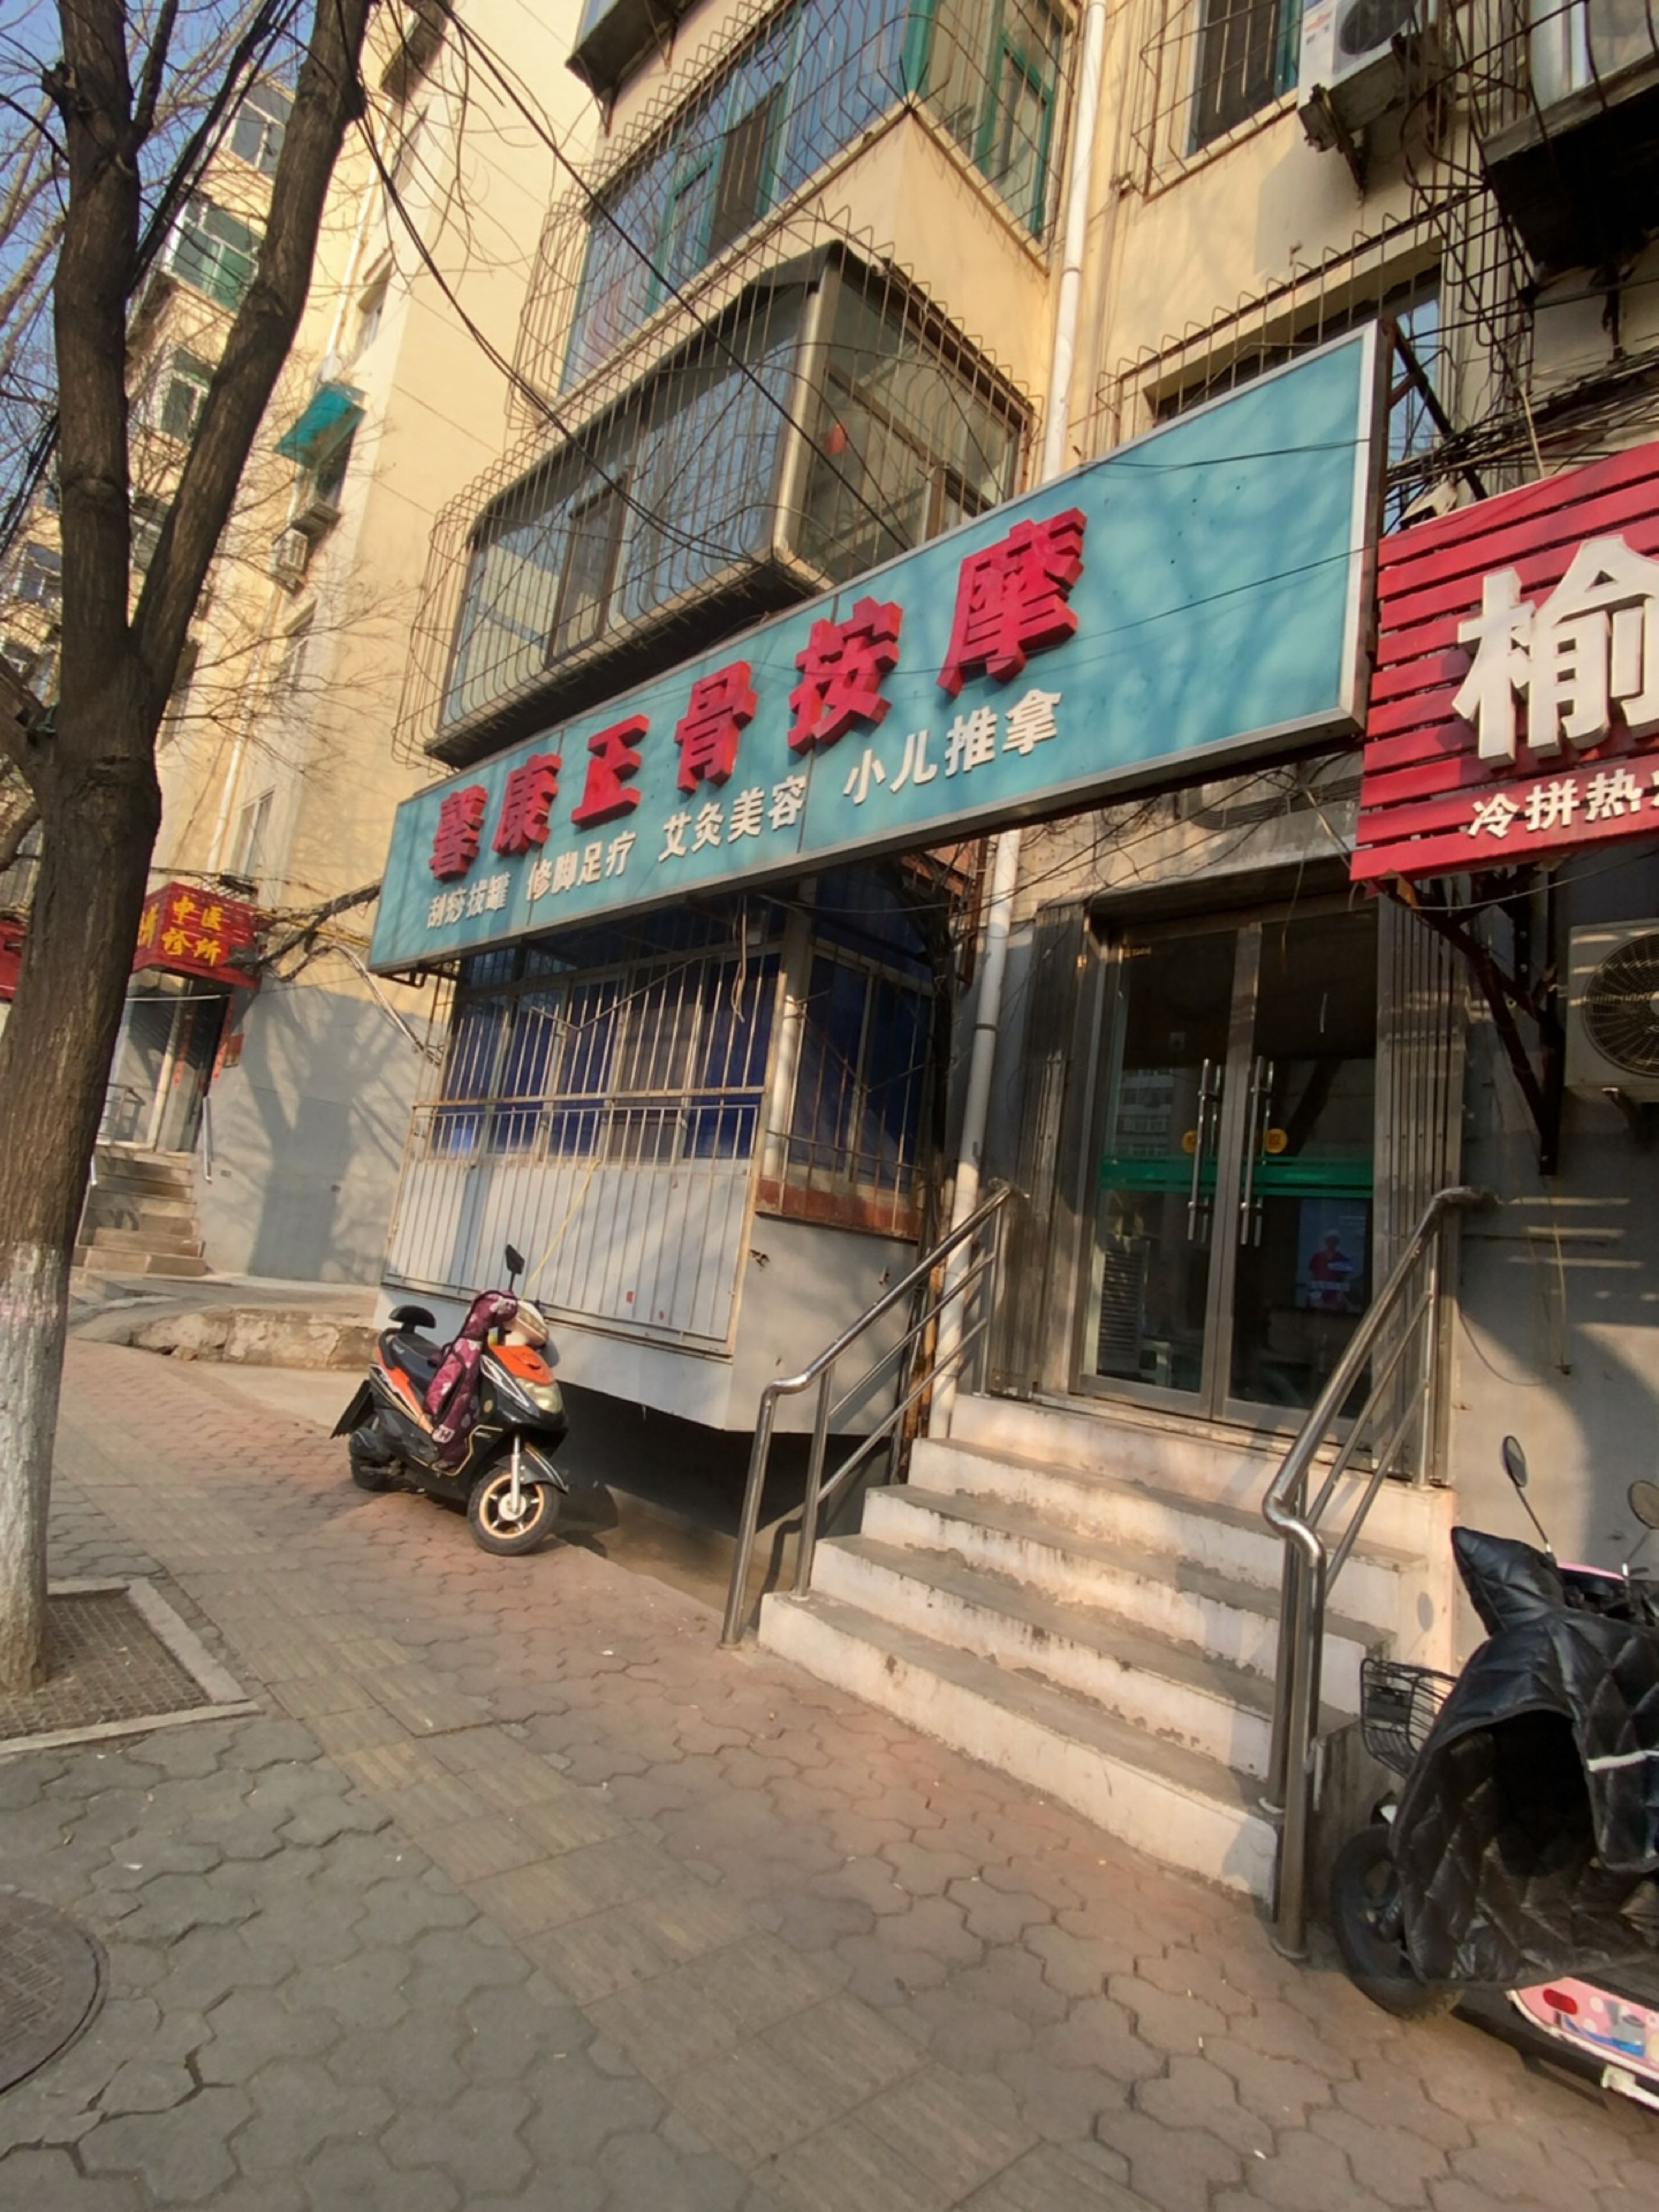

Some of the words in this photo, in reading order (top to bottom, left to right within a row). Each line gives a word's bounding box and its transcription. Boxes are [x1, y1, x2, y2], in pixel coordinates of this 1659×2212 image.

[429, 507, 1087, 882] 馨康正骨按摩
[1452, 534, 1659, 765] 榆
[173, 894, 224, 931] 中医
[426, 871, 512, 929] 刮痧拔罐
[525, 830, 637, 902] 修脚足疗
[658, 774, 807, 863] 艾灸美容
[842, 689, 1062, 806] 小儿推拿
[1468, 767, 1659, 838] 冷拼热
